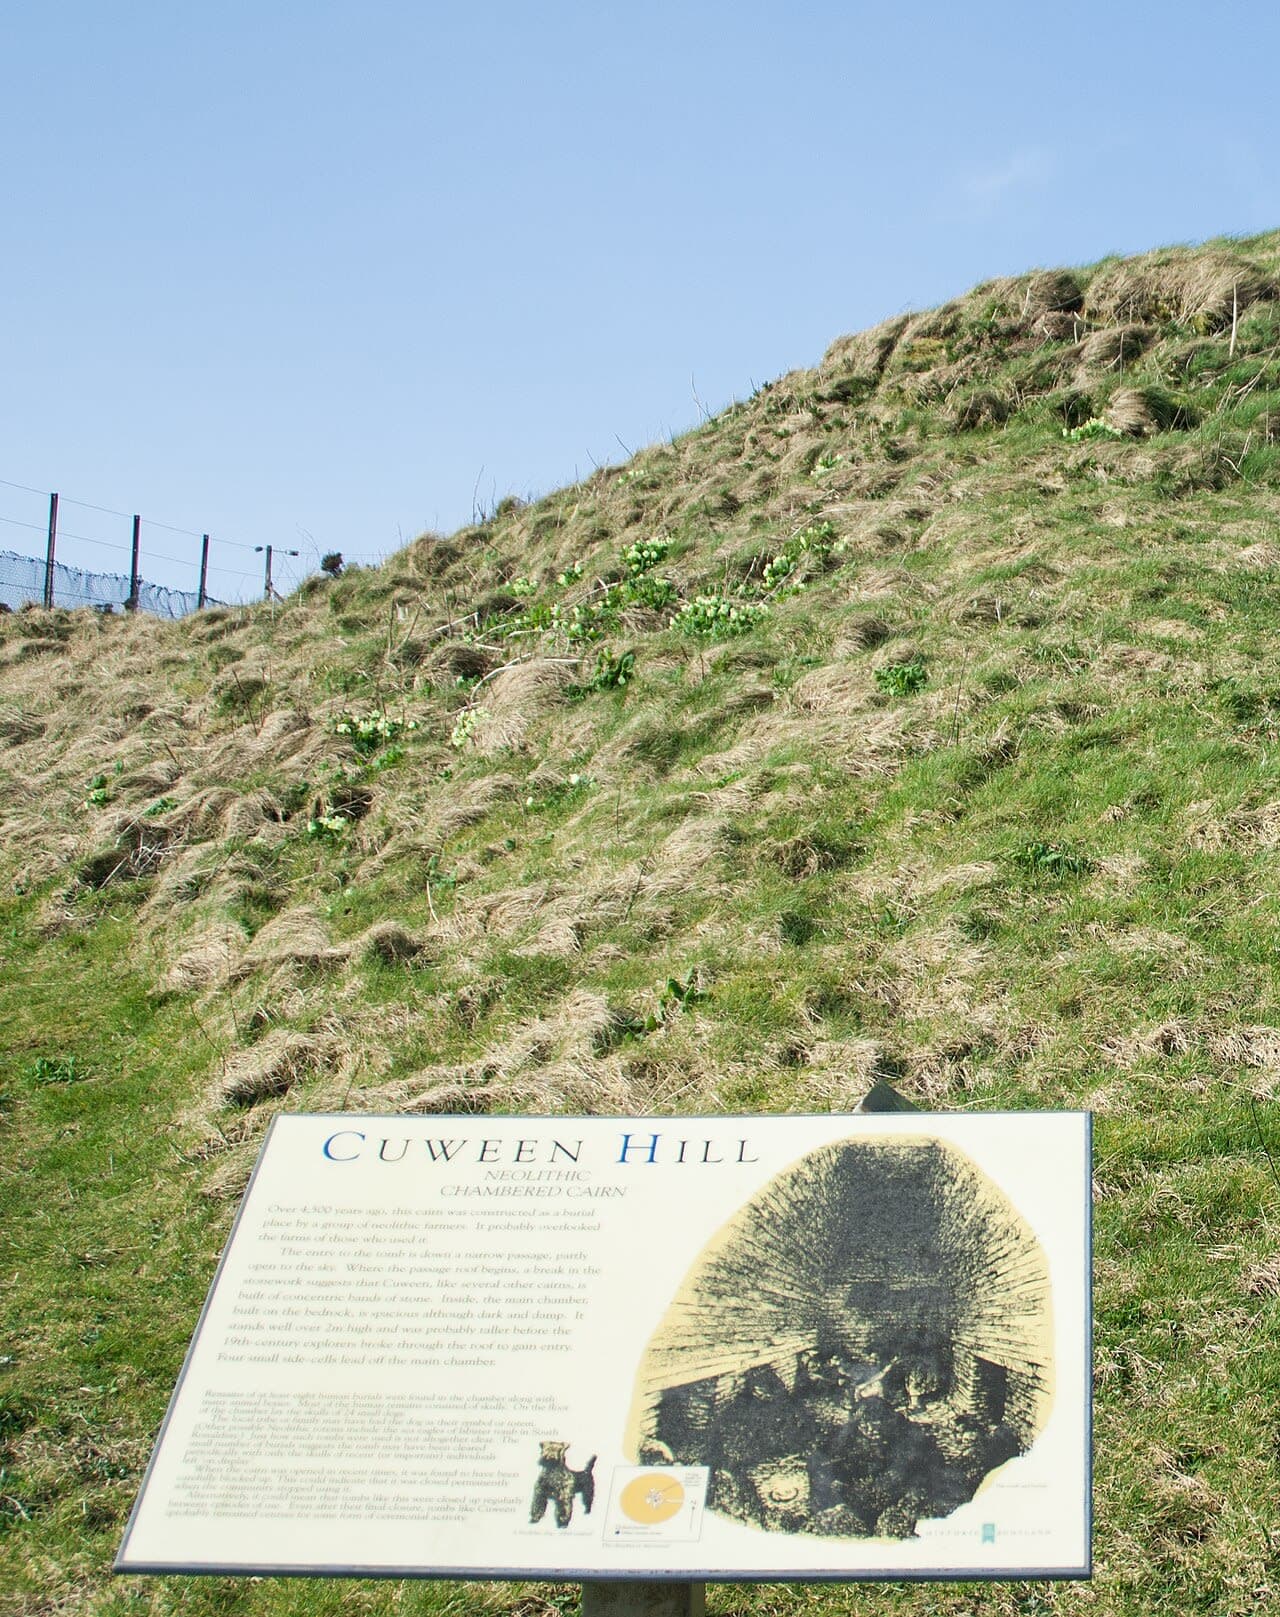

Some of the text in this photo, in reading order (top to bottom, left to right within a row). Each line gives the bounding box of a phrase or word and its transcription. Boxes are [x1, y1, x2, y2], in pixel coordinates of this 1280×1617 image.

[322, 1130, 760, 1165] CUWEEN HILL
[484, 1169, 592, 1183] NEOLITHIC
[440, 1184, 628, 1199] CHAMBERED CAIRN
[267, 1204, 298, 1214] Over
[334, 1207, 362, 1217] years
[391, 1205, 413, 1215] this
[415, 1207, 444, 1216] cairn
[447, 1208, 467, 1216] was
[470, 1206, 536, 1217] constructed
[538, 1209, 550, 1217] as
[561, 1207, 596, 1217] burial
[262, 1218, 292, 1231] place
[296, 1218, 309, 1231] by
[320, 1221, 353, 1231] group
[357, 1219, 369, 1229] of
[371, 1219, 419, 1229] neolithic
[475, 1220, 485, 1230] It
[487, 1220, 536, 1233] probably
[539, 1221, 601, 1231] overlooked
[258, 1231, 276, 1242] the
[280, 1232, 311, 1242] farms
[314, 1232, 326, 1242] of
[329, 1232, 358, 1243] those
[362, 1233, 387, 1243] who
[389, 1233, 416, 1244] used
[280, 1247, 303, 1257] The
[305, 1248, 336, 1260] entry
[339, 1249, 351, 1257] to
[353, 1247, 373, 1258] the
[376, 1248, 406, 1258] tomb
[409, 1249, 417, 1258] is
[419, 1248, 451, 1258] down
[464, 1251, 504, 1259] narrow
[555, 1249, 588, 1262] partly
[248, 1263, 276, 1273] open
[280, 1262, 292, 1271] to
[295, 1261, 314, 1271] the
[345, 1261, 384, 1272] Where
[387, 1262, 407, 1272] the
[409, 1265, 450, 1275] passage
[455, 1262, 479, 1273] roof
[533, 1263, 563, 1274] break
[568, 1265, 579, 1274] in
[583, 1264, 601, 1274] the
[242, 1275, 303, 1286] stonework
[306, 1278, 352, 1289] suggests
[355, 1277, 379, 1287] that
[436, 1278, 457, 1288] like
[461, 1278, 501, 1288] several
[503, 1278, 534, 1289] other
[578, 1281, 586, 1289] is
[237, 1290, 264, 1300] built
[267, 1290, 280, 1301] of
[282, 1292, 344, 1301] concentric
[347, 1291, 382, 1302] bands
[384, 1292, 397, 1302] of
[482, 1293, 502, 1303] the
[504, 1295, 534, 1304] main
[232, 1305, 259, 1316] built
[281, 1306, 300, 1316] the
[359, 1309, 369, 1317] is
[371, 1309, 419, 1320] spacious
[423, 1308, 474, 1321] although
[477, 1309, 503, 1319] dark
[507, 1309, 529, 1320] and
[575, 1310, 584, 1320] It
[228, 1321, 265, 1331] stands
[268, 1321, 293, 1331] well
[295, 1324, 321, 1332] over
[325, 1322, 343, 1332] 2m
[346, 1322, 372, 1335] high
[375, 1323, 398, 1333] and
[425, 1323, 476, 1336] probably
[479, 1324, 510, 1334] taller
[513, 1325, 549, 1335] before
[552, 1325, 572, 1335] the
[303, 1337, 356, 1350] explorers
[361, 1338, 394, 1349] broke
[397, 1339, 443, 1352] through
[447, 1340, 467, 1350] the
[470, 1340, 496, 1350] roof
[497, 1342, 510, 1351] to
[511, 1342, 537, 1353] gain
[217, 1351, 247, 1362] Four
[247, 1352, 279, 1363] small
[340, 1354, 366, 1364] lead
[368, 1354, 385, 1365] off
[388, 1355, 407, 1365] the
[410, 1357, 440, 1366] main
